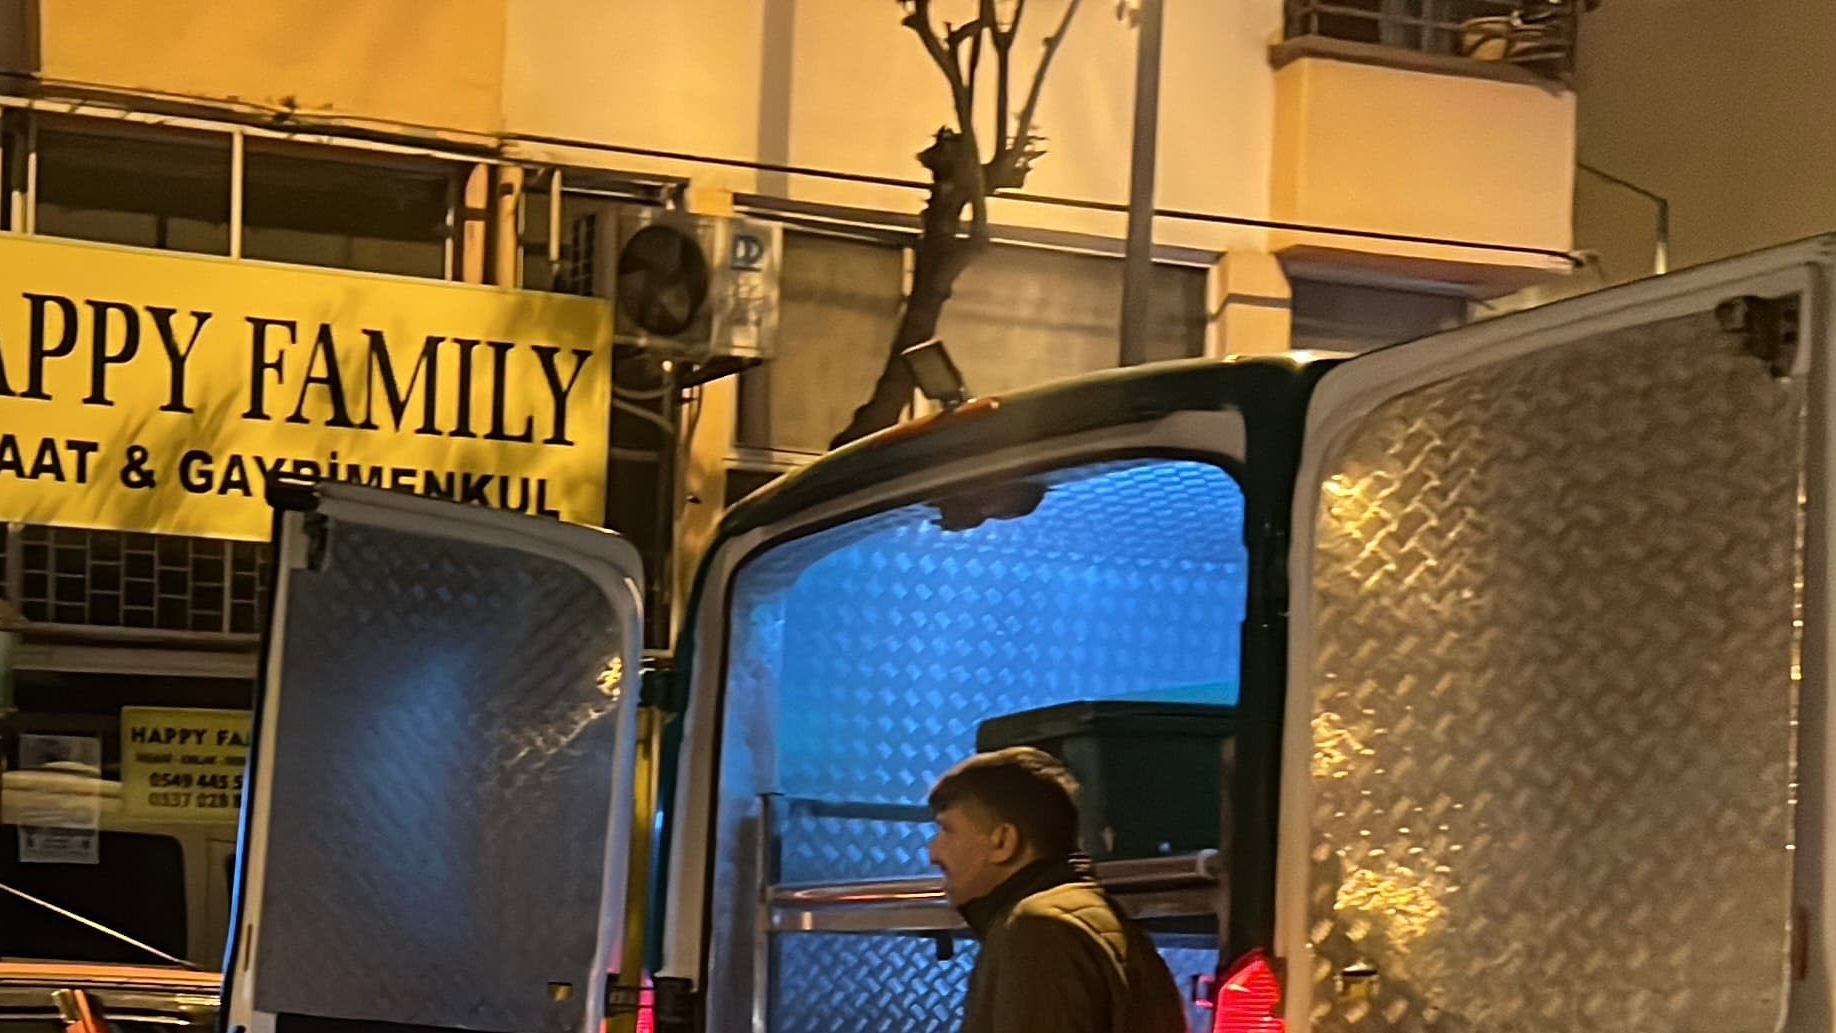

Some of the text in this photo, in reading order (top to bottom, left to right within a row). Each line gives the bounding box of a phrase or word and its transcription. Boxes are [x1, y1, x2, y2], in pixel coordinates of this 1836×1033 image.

[243, 315, 592, 446] FAMILY
[120, 448, 158, 490] &
[131, 726, 251, 746] HAPPY FA
